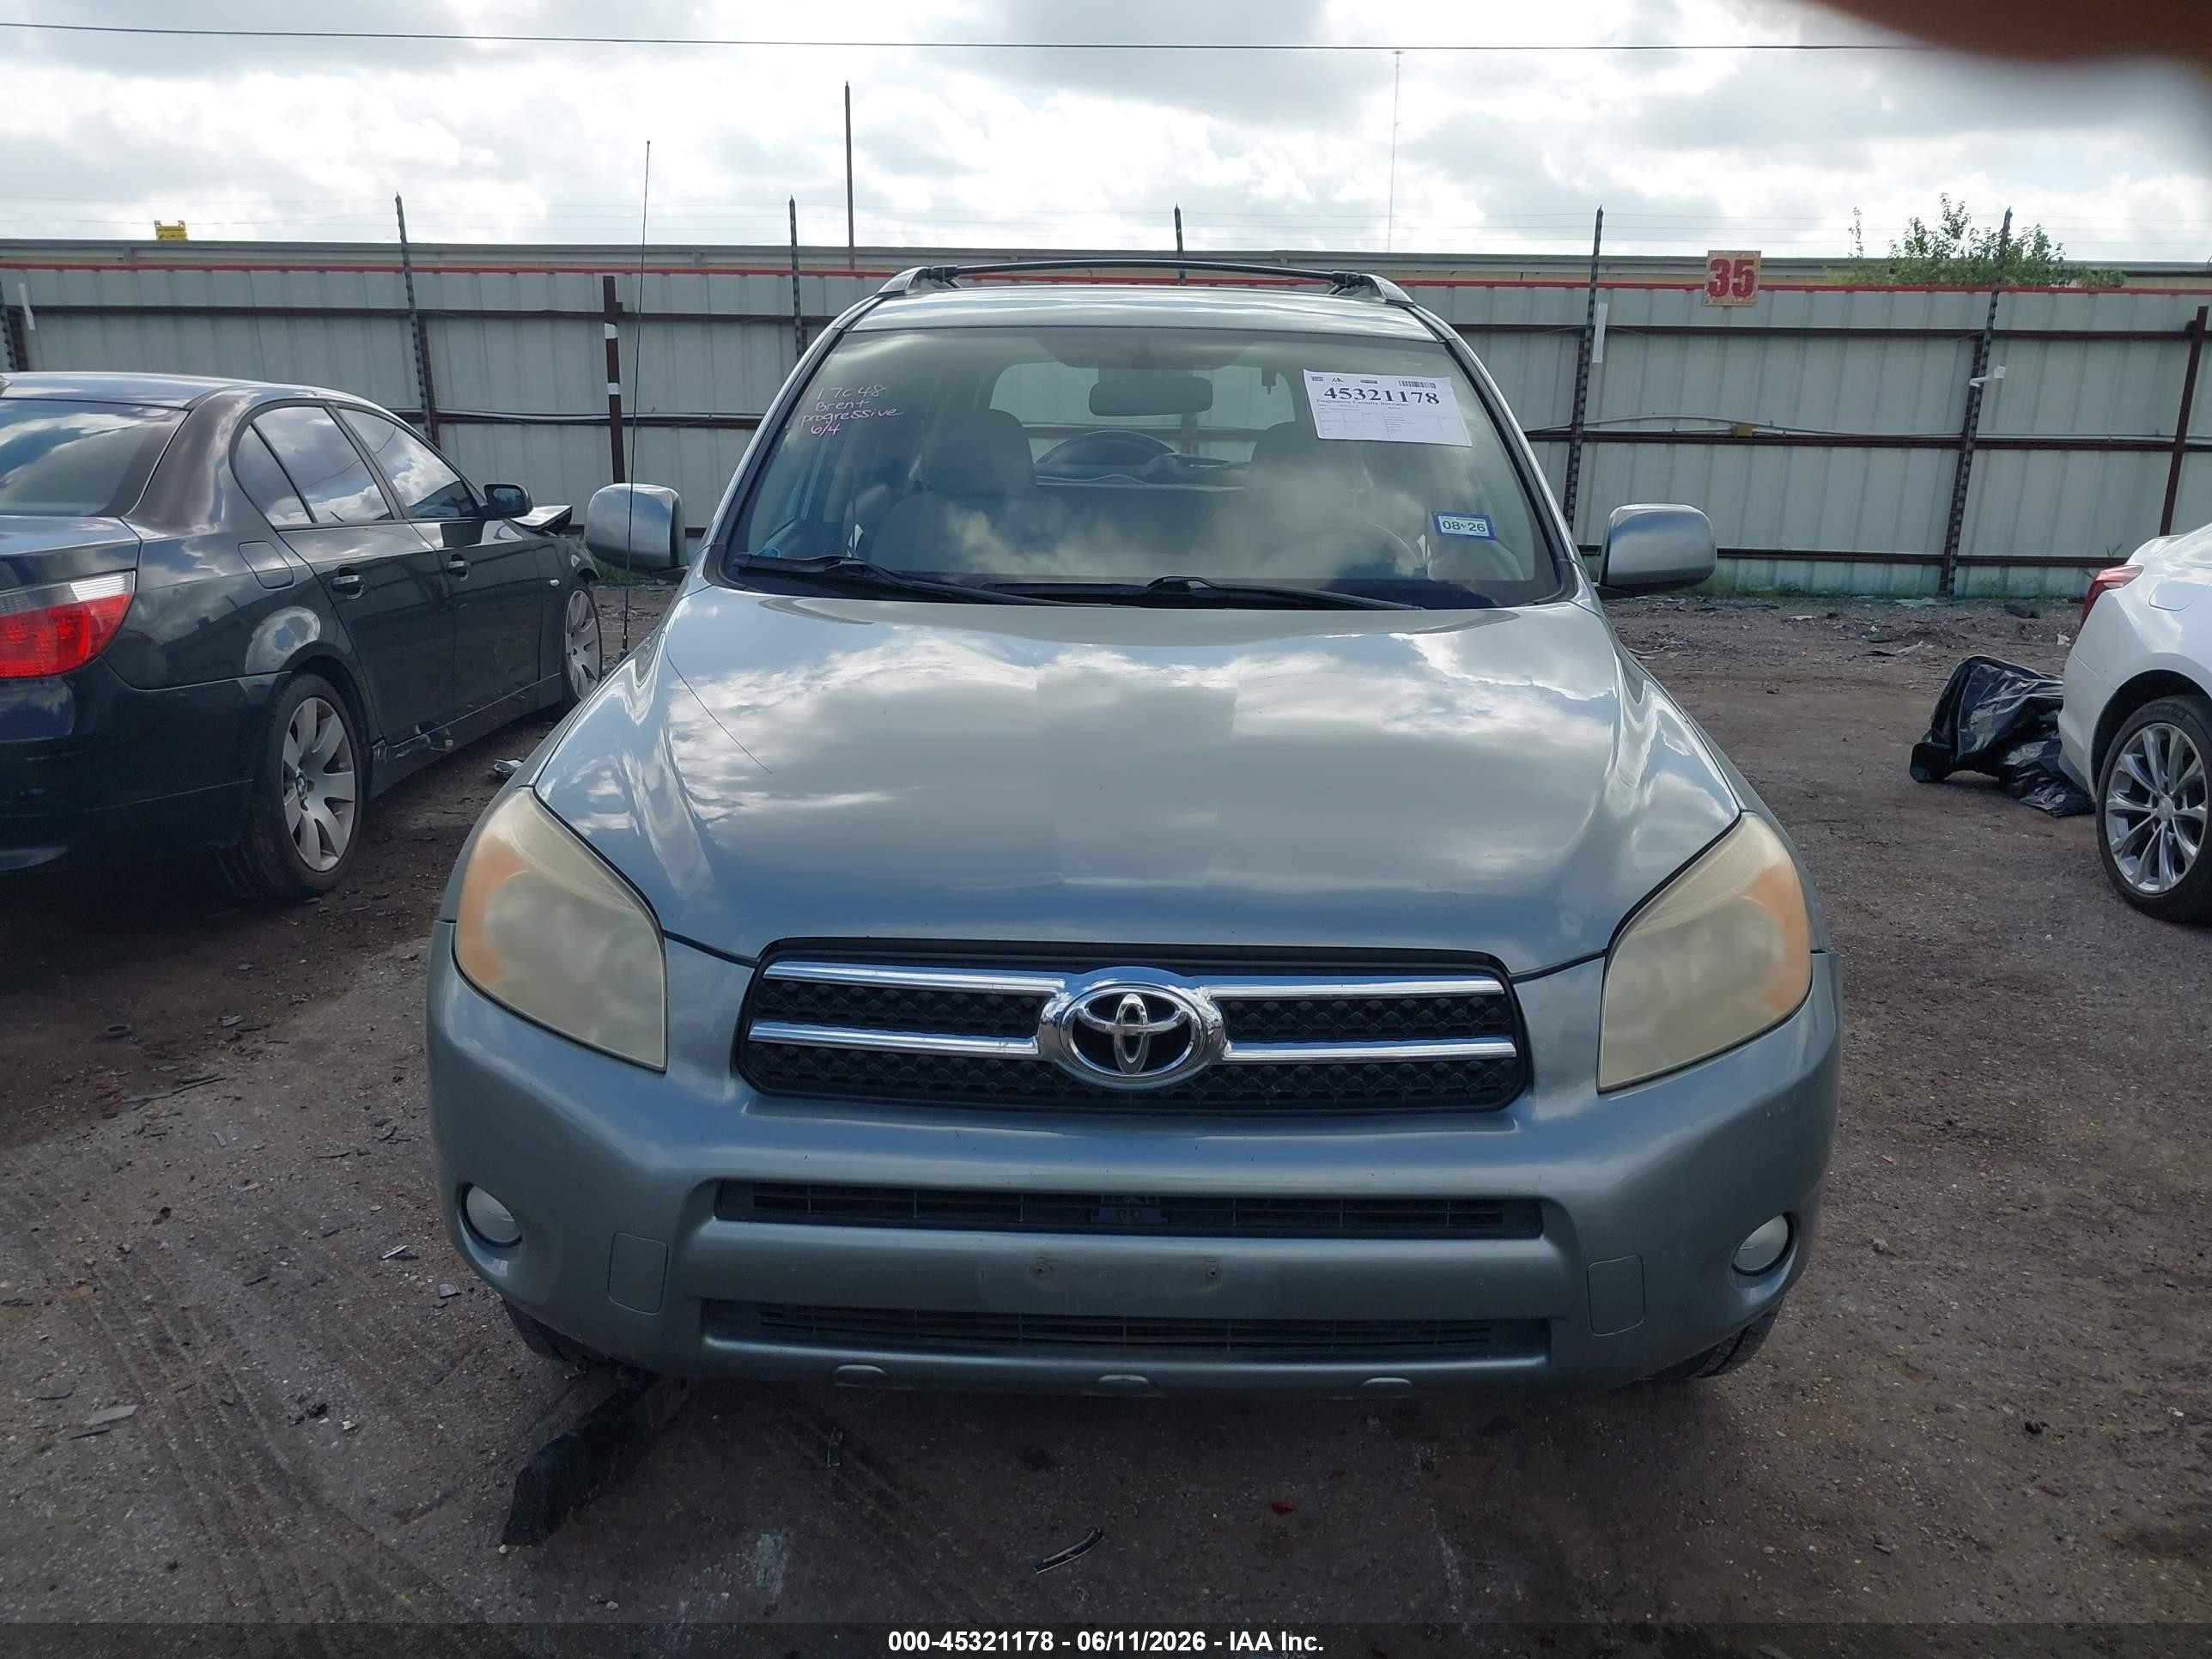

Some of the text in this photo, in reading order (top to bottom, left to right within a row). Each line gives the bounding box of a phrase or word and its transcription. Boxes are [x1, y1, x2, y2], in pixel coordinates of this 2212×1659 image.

[1708, 258, 1755, 298] 35
[1323, 387, 1440, 404] 45321178
[816, 399, 871, 411] Brent
